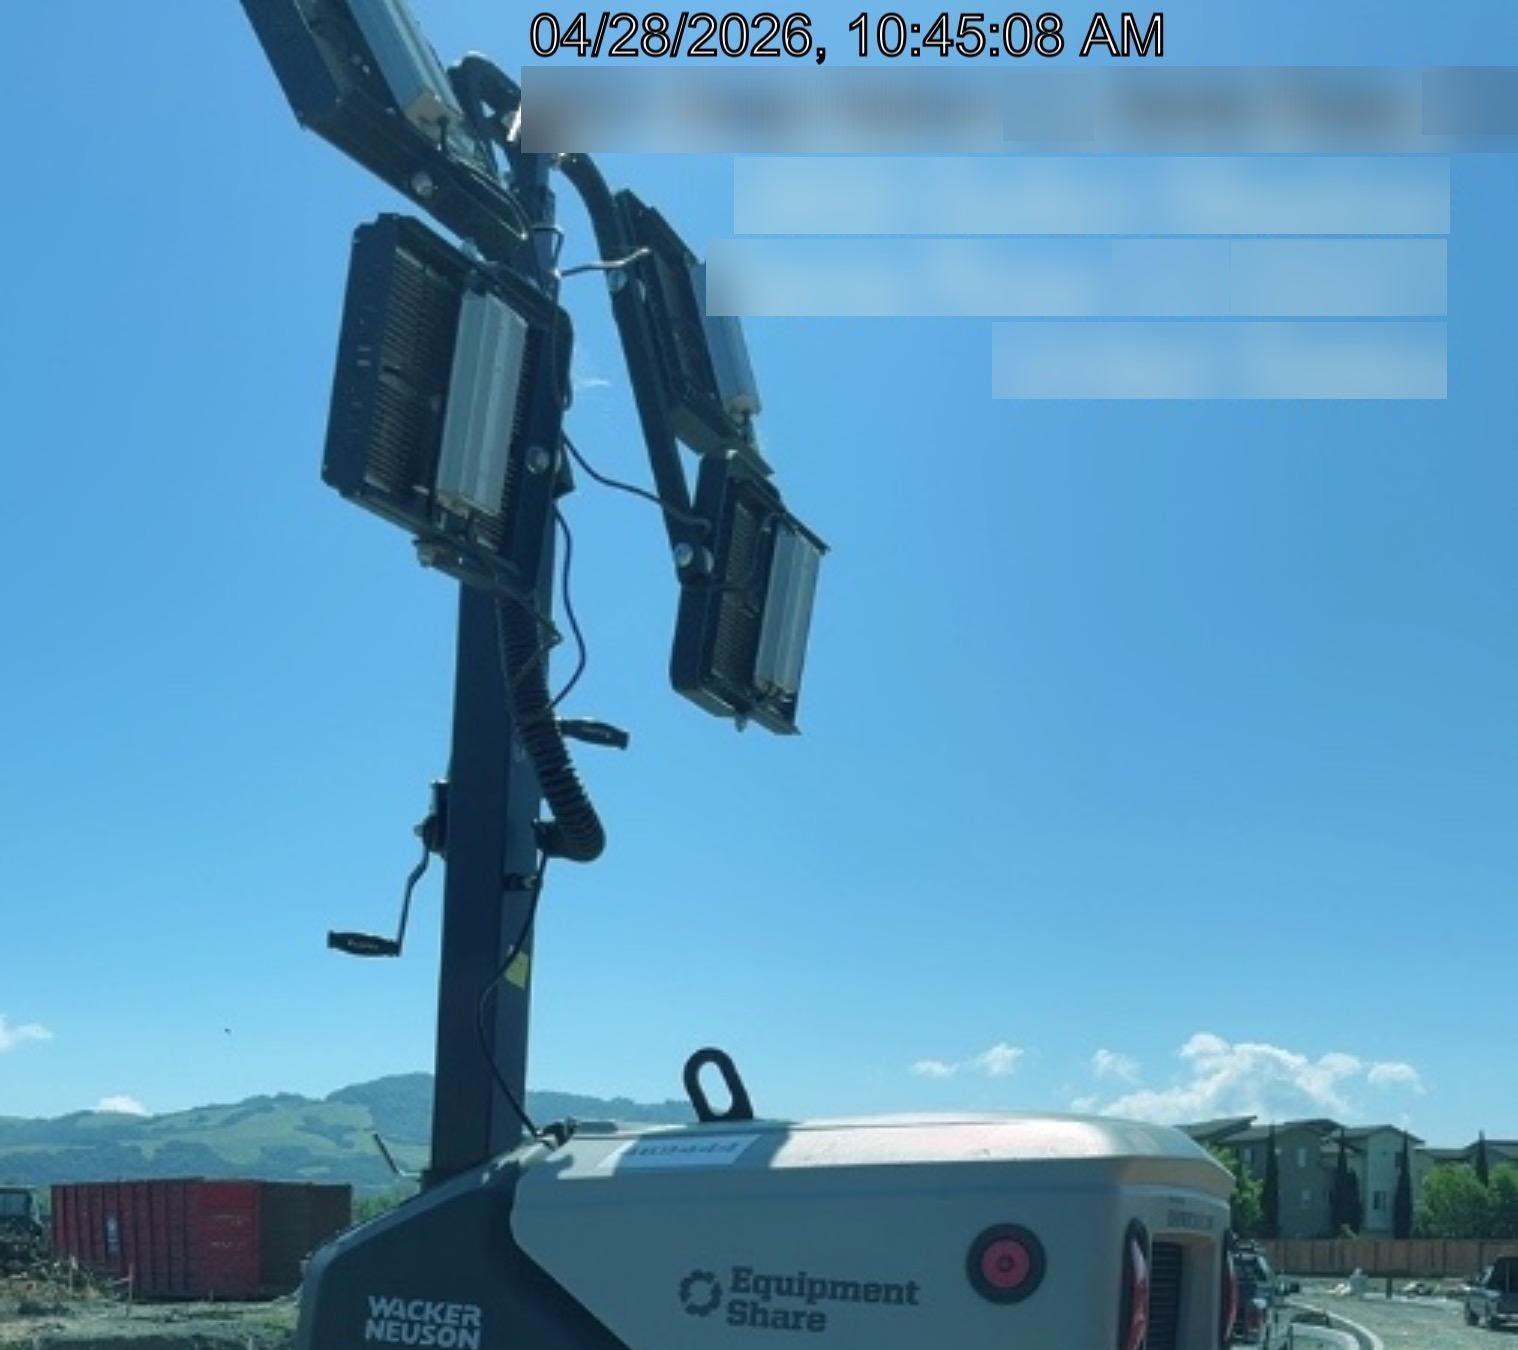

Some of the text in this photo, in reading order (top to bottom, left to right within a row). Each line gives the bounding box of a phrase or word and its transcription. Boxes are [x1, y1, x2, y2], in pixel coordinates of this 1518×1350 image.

[729, 1266, 920, 1306] Equipment
[368, 1295, 481, 1327] WACKER
[726, 1299, 827, 1333] Share
[365, 1318, 481, 1350] NEUSON
